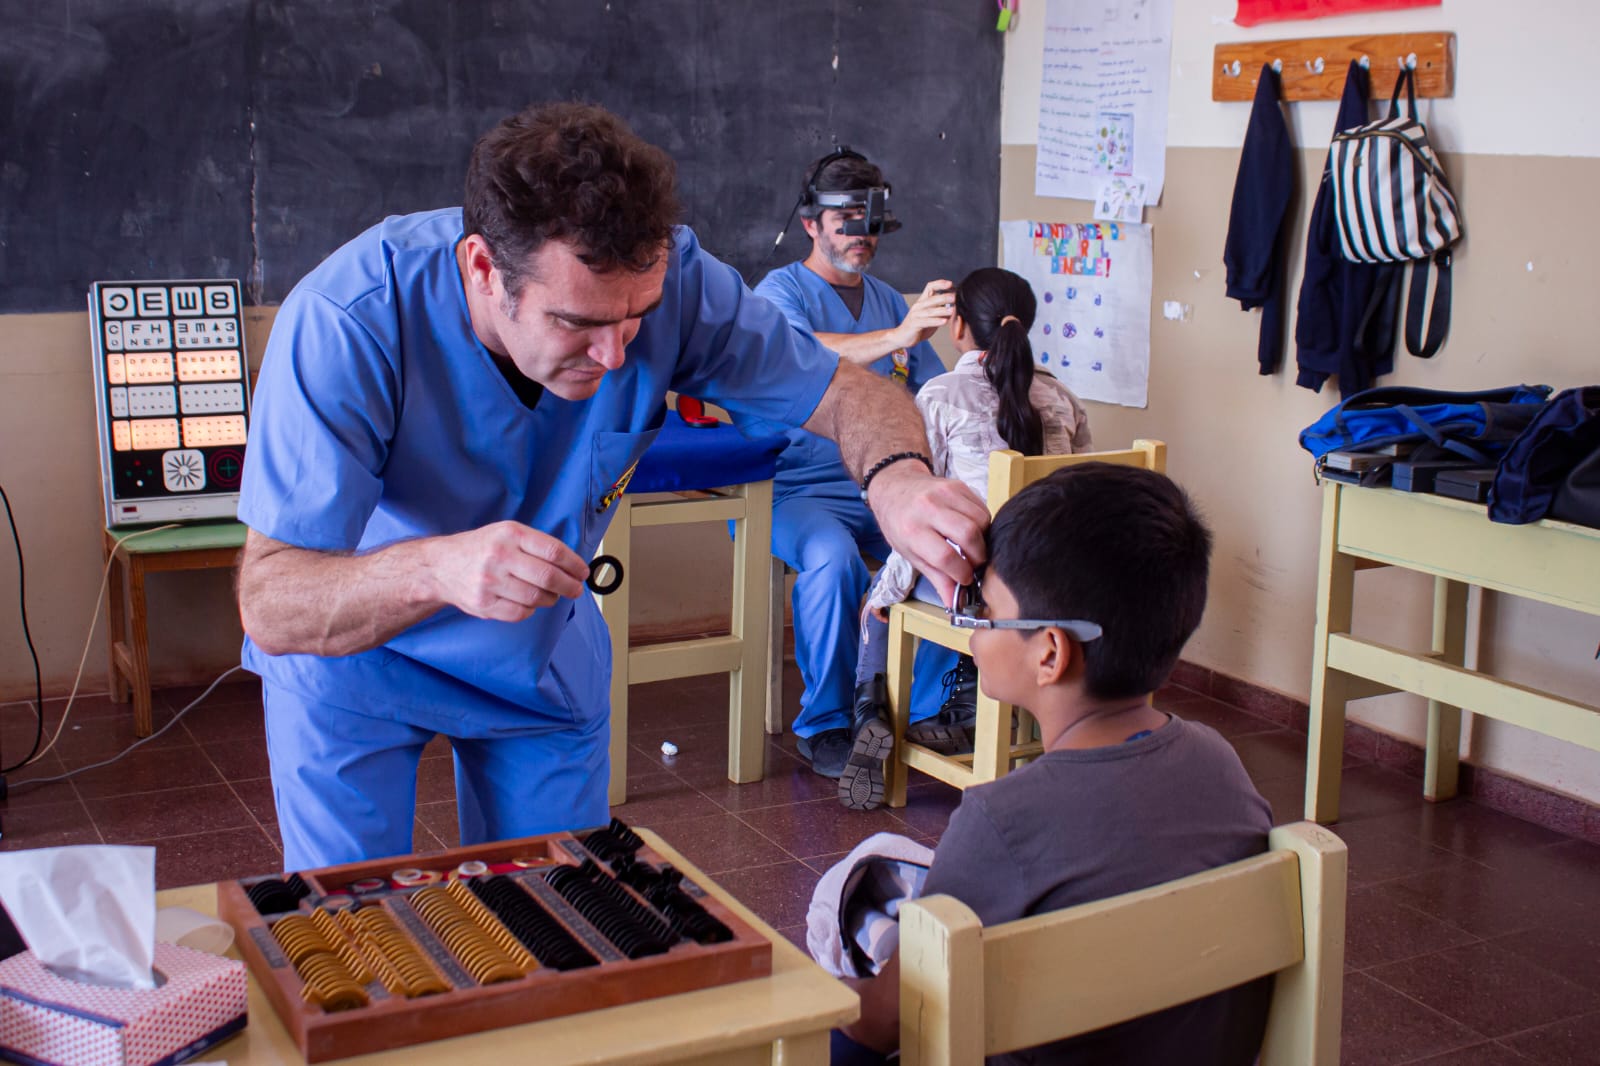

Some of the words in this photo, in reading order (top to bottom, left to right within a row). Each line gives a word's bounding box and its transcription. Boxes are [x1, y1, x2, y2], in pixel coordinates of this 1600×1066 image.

[143, 292, 163, 311] E
[131, 324, 142, 334] F
[151, 323, 162, 334] H
